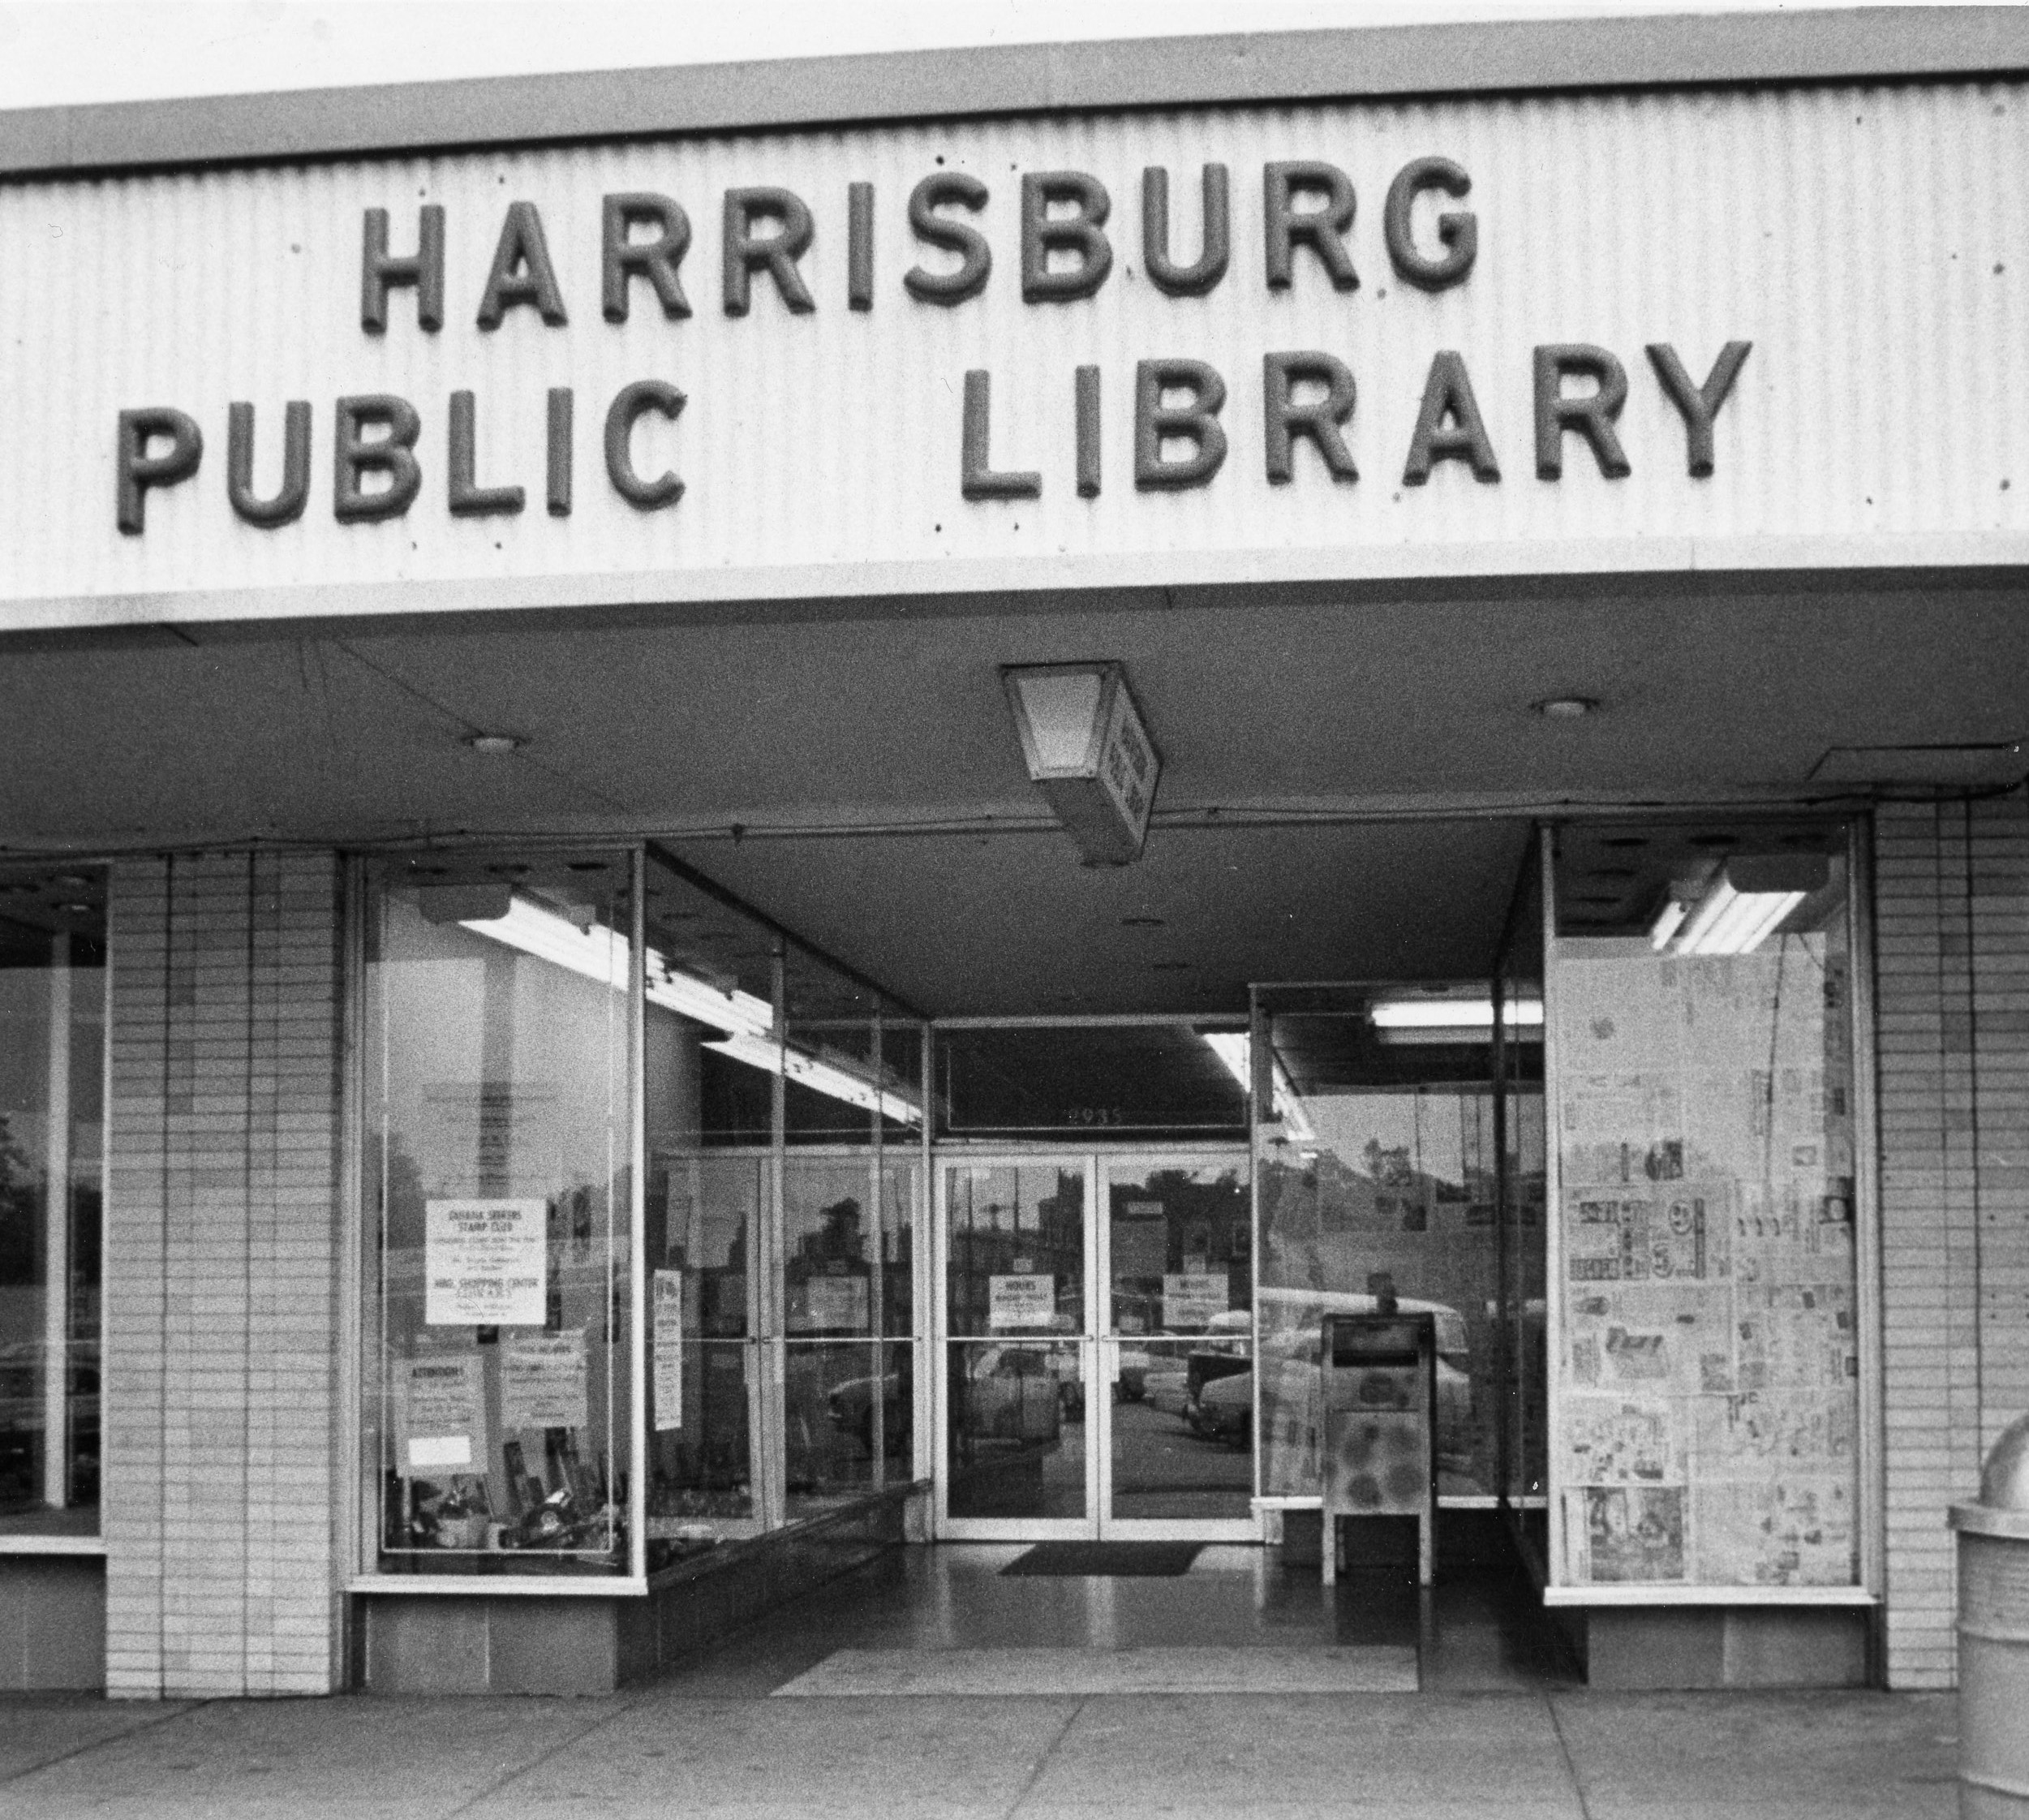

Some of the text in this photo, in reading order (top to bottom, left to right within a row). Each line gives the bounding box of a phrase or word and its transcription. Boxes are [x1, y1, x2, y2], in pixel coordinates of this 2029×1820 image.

[360, 156, 1479, 334] HARRISBURG
[116, 340, 1753, 536] PUBLIC LIBRARY
